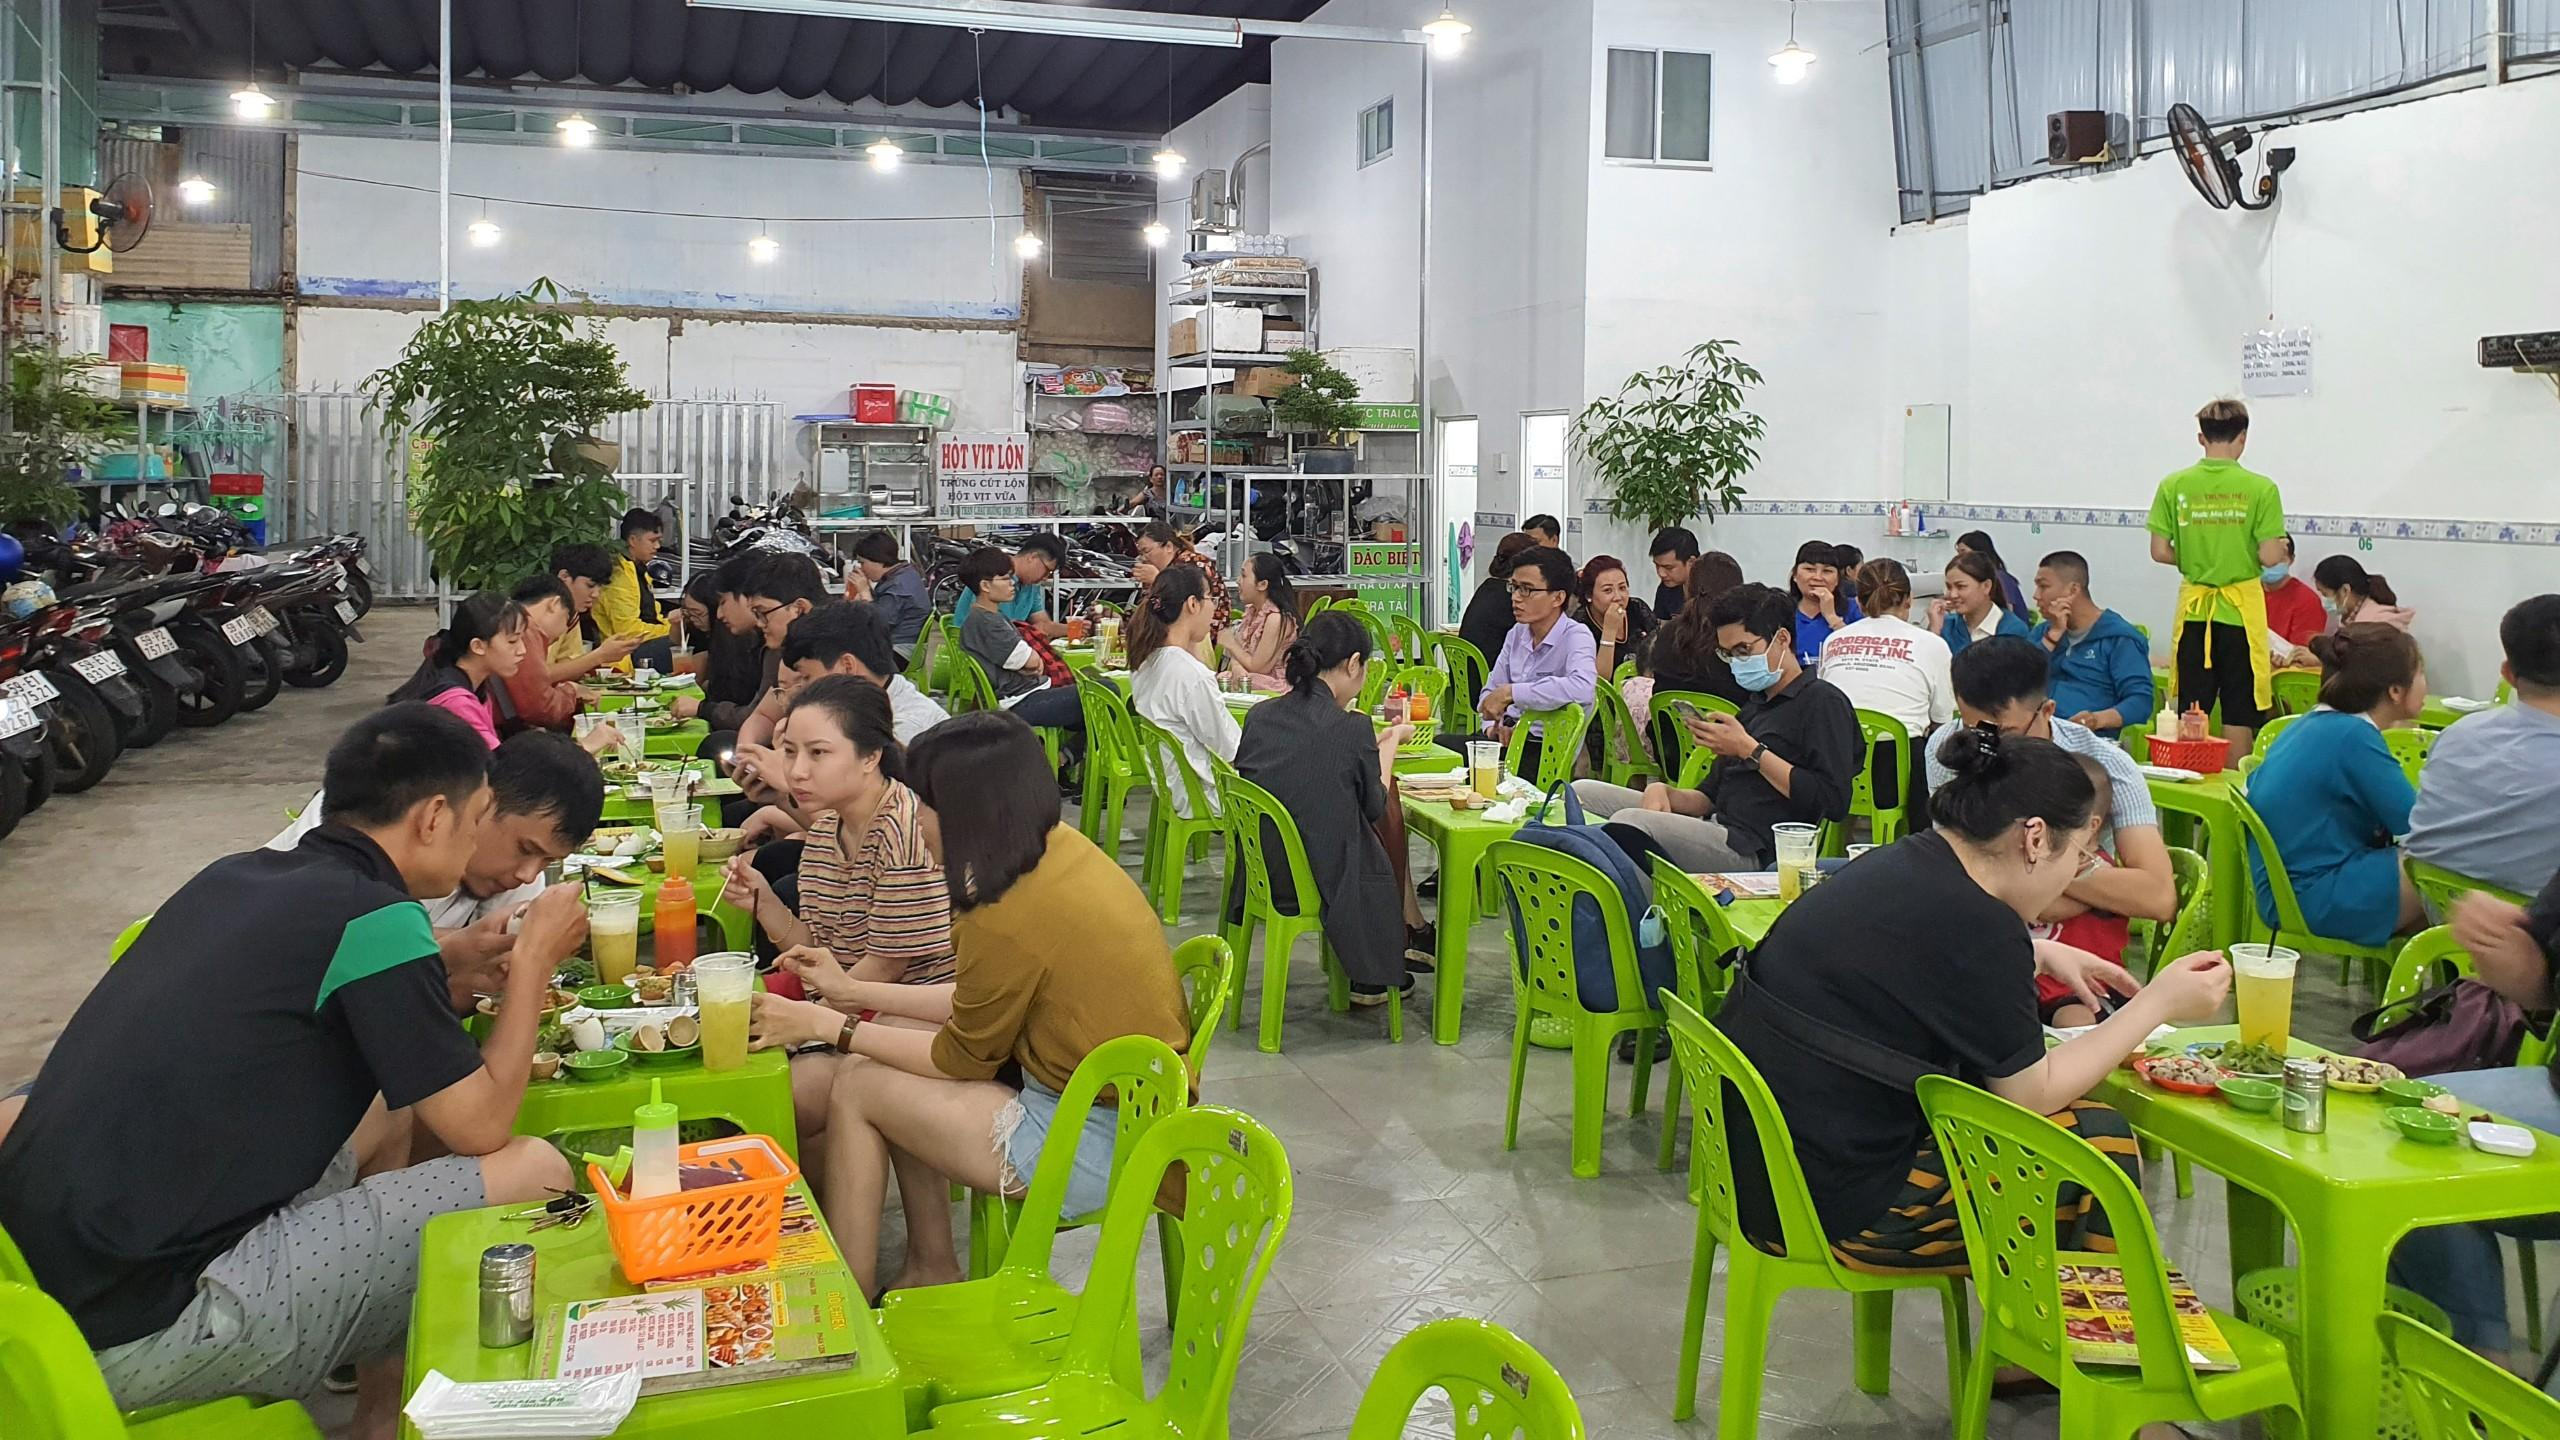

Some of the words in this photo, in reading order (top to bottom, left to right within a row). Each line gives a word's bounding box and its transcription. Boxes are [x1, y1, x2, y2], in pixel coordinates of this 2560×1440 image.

[942, 435, 968, 473] HỘT
[972, 443, 994, 473] VỊT
[998, 436, 1024, 473] LỘN
[980, 477, 1001, 488] CÚT
[1004, 477, 1025, 490] LỘN
[948, 491, 970, 501] HỘT
[973, 492, 991, 502] VỊT
[995, 491, 1016, 500] VỮA
[2359, 537, 2373, 551] 06
[1353, 547, 1382, 568] ĐẶC
